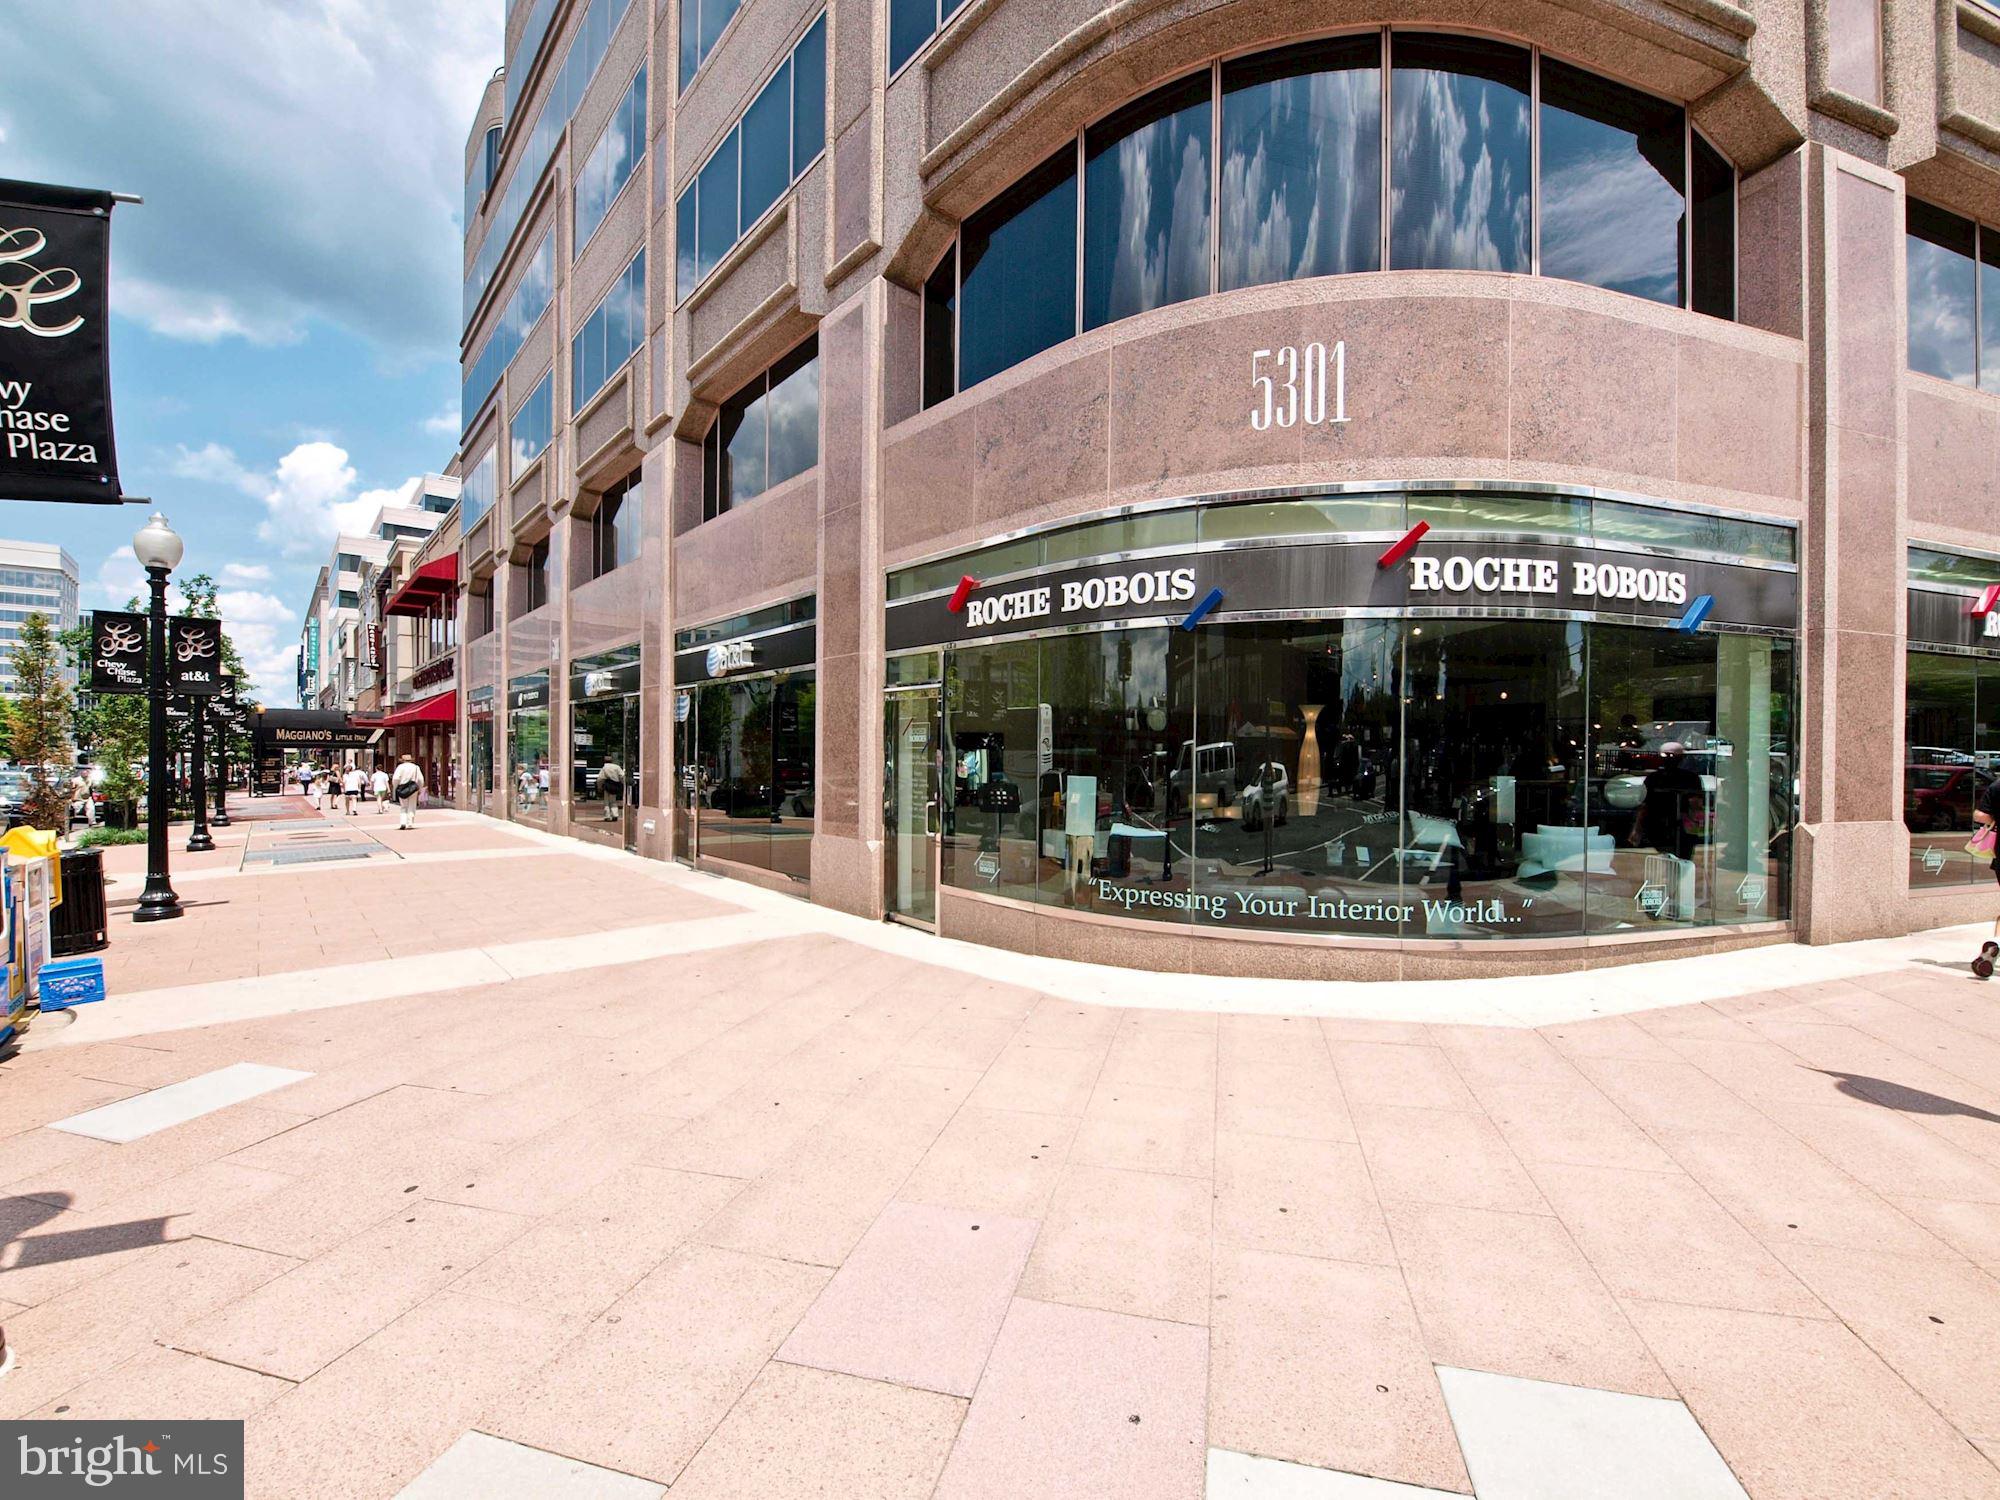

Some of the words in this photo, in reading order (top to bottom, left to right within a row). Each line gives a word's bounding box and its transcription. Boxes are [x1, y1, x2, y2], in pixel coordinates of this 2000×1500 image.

[1251, 341, 1352, 430] 5301
[7, 432, 98, 463] Plaza
[1410, 556, 1558, 593] ROCHE
[1573, 562, 1687, 604] BOBOIS
[966, 587, 1051, 628] ROCHE
[1061, 568, 1196, 612] BOBOIS
[1983, 611, 2000, 637] R
[96, 659, 128, 670] Chevy
[106, 668, 137, 676] Chase
[180, 671, 211, 682] at&t
[116, 675, 143, 684] Plaza
[276, 728, 332, 740] MAGGIANO'S
[1234, 891, 1299, 917] Your
[1307, 895, 1414, 922] Interior
